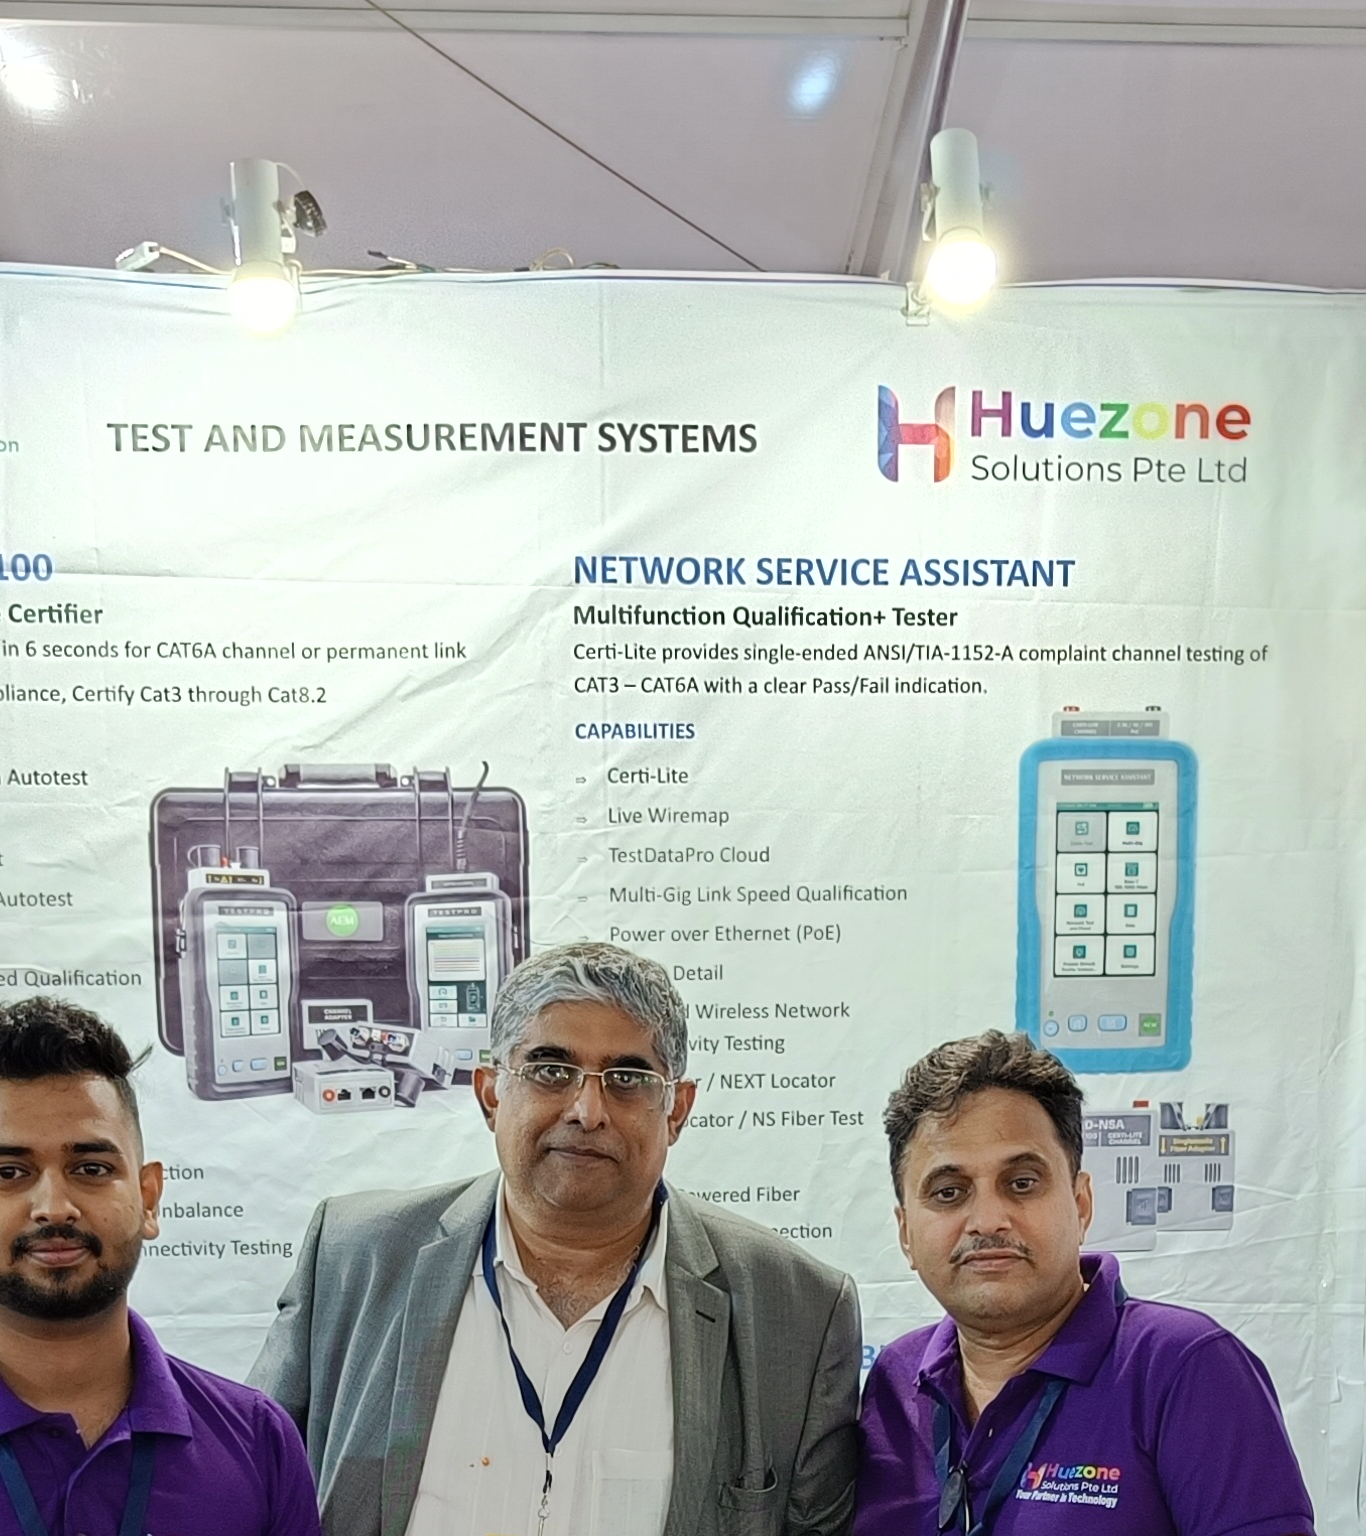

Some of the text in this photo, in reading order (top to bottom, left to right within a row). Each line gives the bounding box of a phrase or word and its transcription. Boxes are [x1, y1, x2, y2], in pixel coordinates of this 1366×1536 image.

[970, 389, 1252, 441] Huezone
[106, 421, 758, 454] TEST AND MEASUREMENT SYSTEMS
[971, 453, 1247, 483] Solutions Pte Ltd
[574, 554, 1076, 588] NETWORK SERVICE ASSISTANT
[7, 602, 104, 625] Certifier
[573, 603, 959, 629] Multifunction Qualification+ Tester
[1, 638, 20, 657] in
[24, 639, 38, 658] 6
[42, 640, 120, 659] seconds
[123, 640, 152, 659] for
[156, 641, 218, 659] CAT6A
[221, 641, 296, 660] channel
[300, 646, 322, 660] or
[326, 643, 429, 664] permanent
[434, 640, 467, 659] link
[573, 642, 1268, 666] Certi-Lite provides single-ended ANSI/TIA-1152-A complaint channel testing of
[71, 683, 136, 707] Certify
[139, 685, 183, 703] Cat3
[187, 684, 263, 707] through
[267, 686, 327, 704] Cat8.2
[573, 676, 620, 694] CAT3
[640, 676, 700, 694] CAT6A
[703, 675, 743, 694] with
[747, 680, 758, 695] a
[763, 676, 808, 695] clear
[812, 675, 890, 697] Pass/Fail
[894, 676, 988, 695] indication.
[574, 722, 696, 740] CAPABILITIES
[6, 768, 89, 787] Autotest
[606, 766, 689, 785] Certi-Lite
[608, 845, 771, 864] TestDataPro Cloud
[609, 923, 842, 944] Power over Ethernet (PoE)
[23, 968, 143, 989] Qualification
[1046, 1463, 1121, 1481] Huezone
[1040, 1480, 1119, 1494] Solutions Pte Ltd
[1068, 1492, 1118, 1509] Technology
